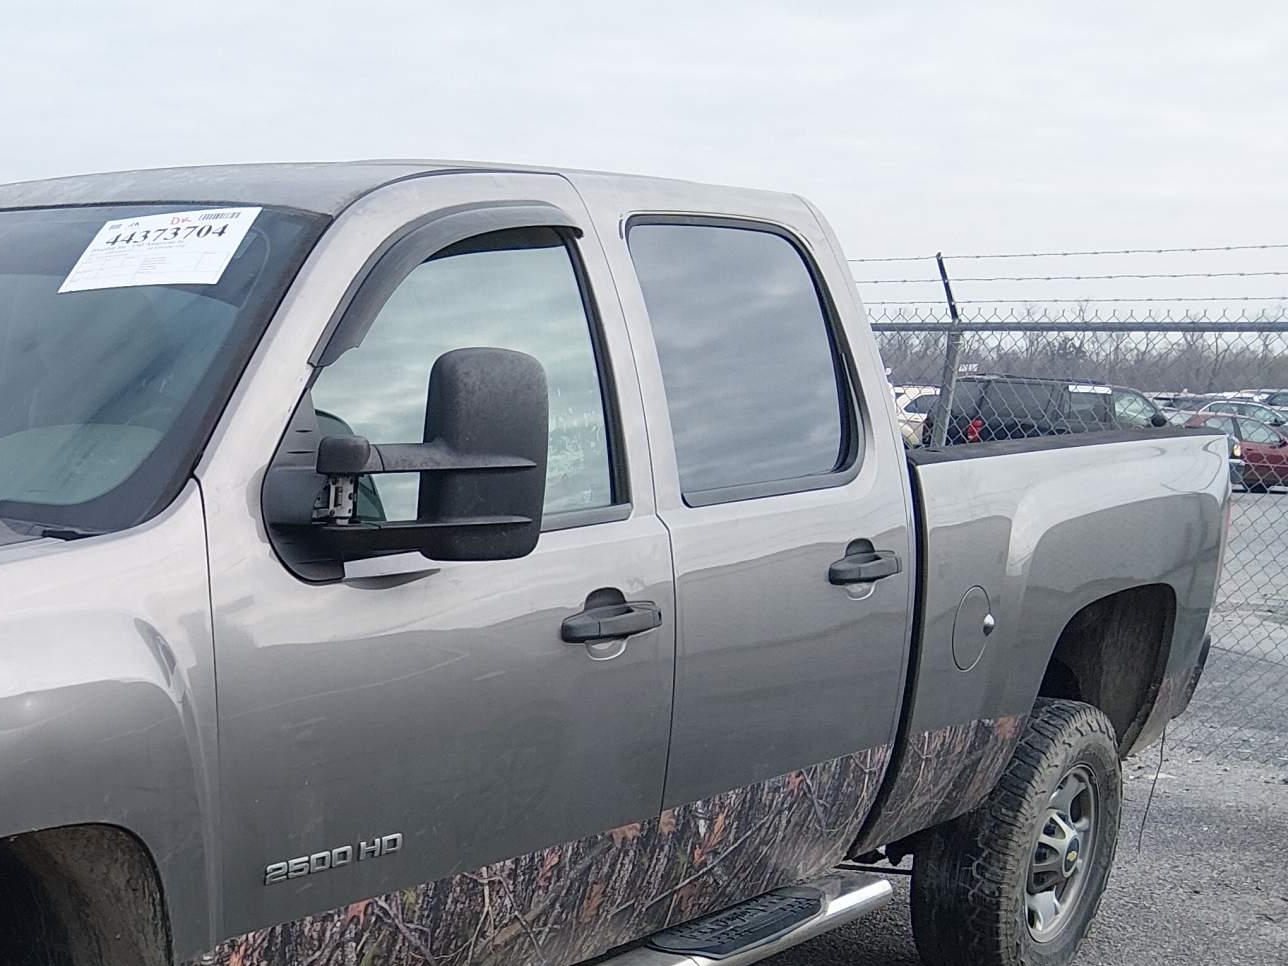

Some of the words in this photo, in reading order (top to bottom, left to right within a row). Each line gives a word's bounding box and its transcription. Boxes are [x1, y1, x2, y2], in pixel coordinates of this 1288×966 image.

[106, 223, 229, 246] 44373704
[264, 845, 353, 886] 2500
[358, 832, 403, 861] HD
